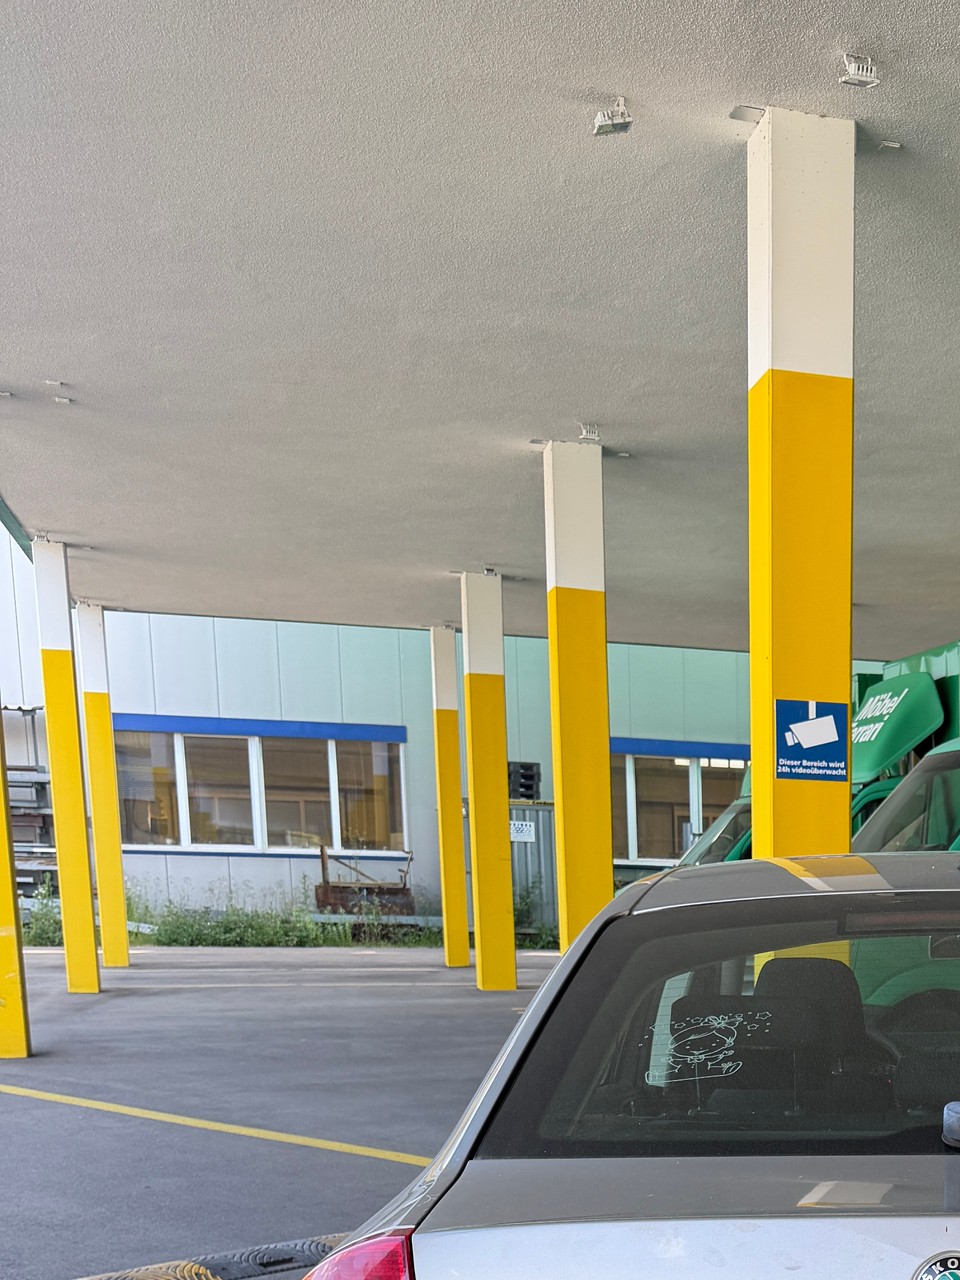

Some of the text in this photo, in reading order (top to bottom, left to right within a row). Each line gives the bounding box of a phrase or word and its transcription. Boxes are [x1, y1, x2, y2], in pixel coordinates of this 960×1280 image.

[855, 688, 909, 722] Möbel
[778, 758, 845, 769] Dieser Bereich wird
[777, 766, 847, 777] 24h videoüberwacht
